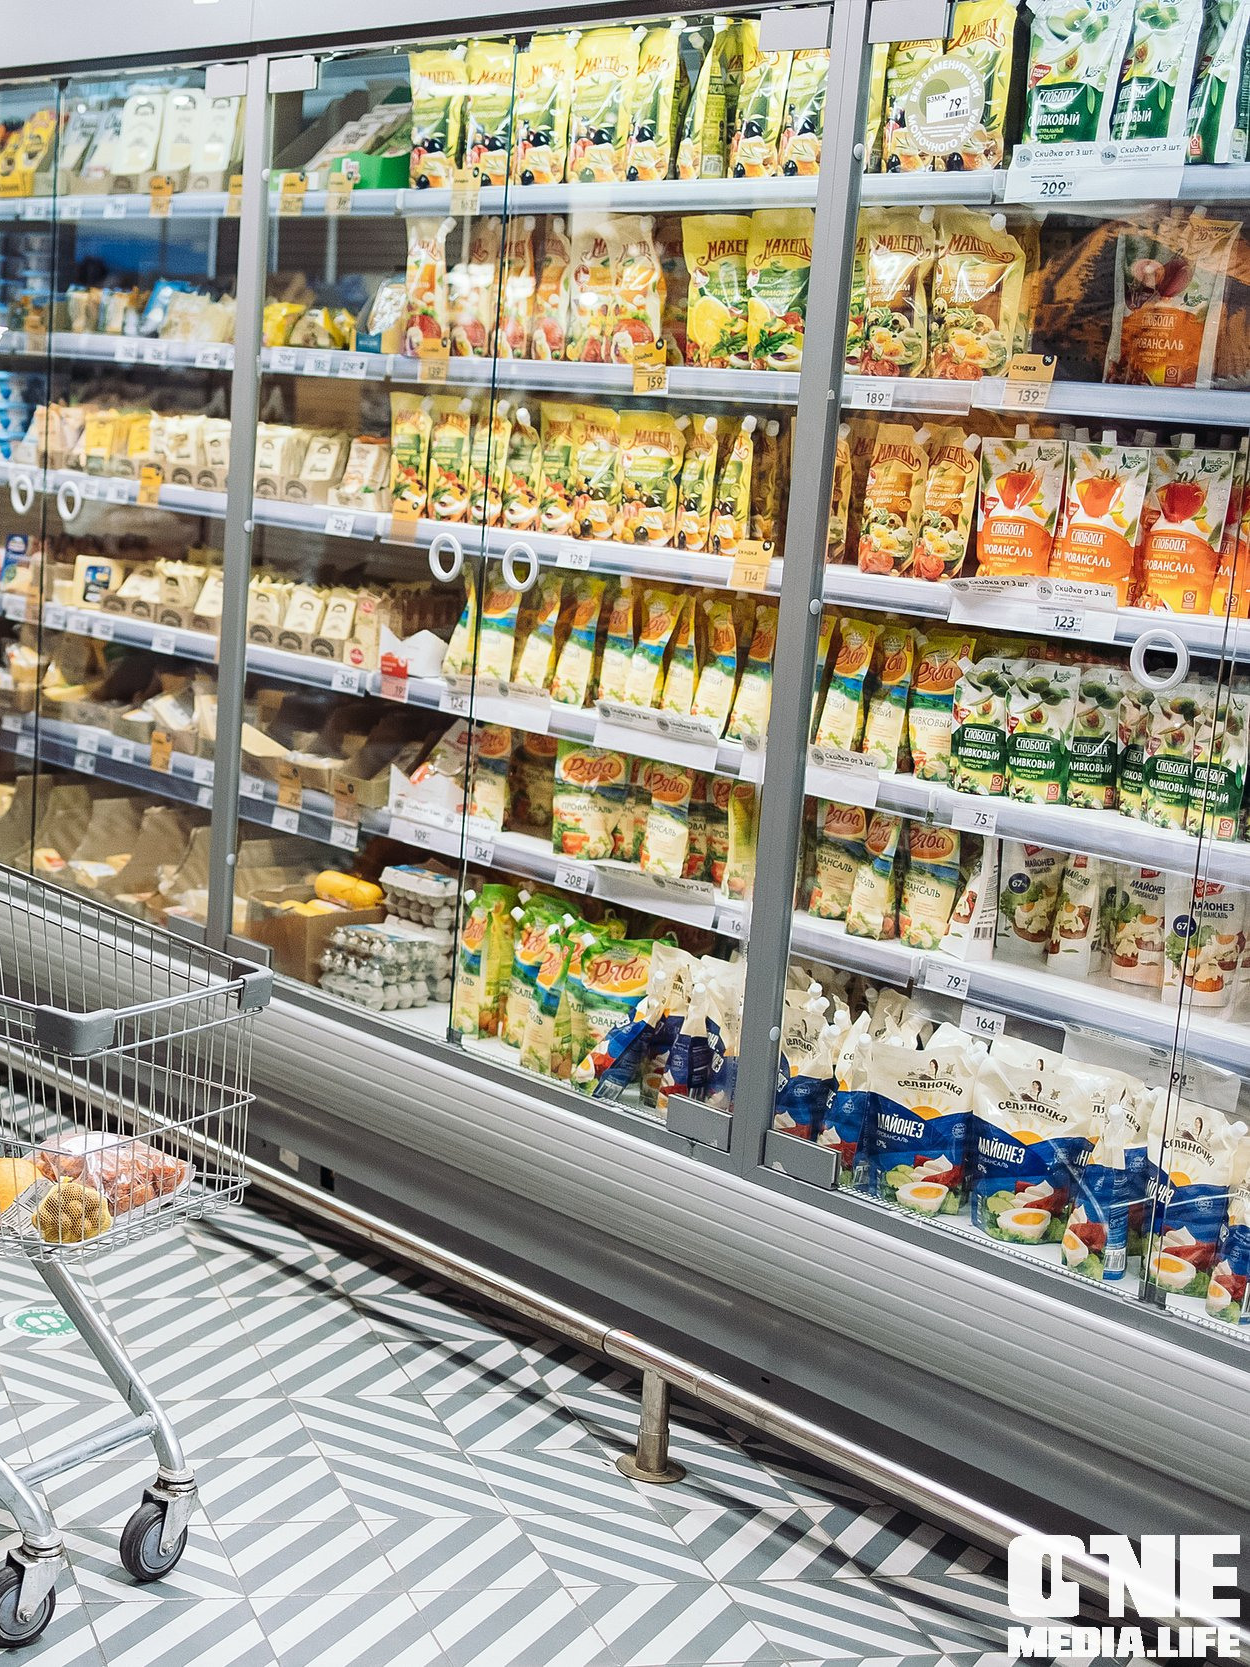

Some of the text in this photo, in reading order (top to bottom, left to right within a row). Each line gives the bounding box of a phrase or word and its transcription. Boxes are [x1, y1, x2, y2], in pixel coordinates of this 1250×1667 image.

[911, 59, 983, 103] БЕЗ ЗАМЕНИТЕЛЕЙ
[907, 114, 958, 153] МОЛОЧНОГО
[1034, 149, 1064, 158] Скидка
[1120, 145, 1149, 154] Скидка
[1040, 181, 1067, 195] 209
[866, 392, 885, 404] 189
[1017, 390, 1040, 402] 139
[991, 524, 1025, 536] СЛОБОДА
[1071, 531, 1104, 545] СЛОБОДА
[1152, 538, 1187, 552] СЛОБОДА
[1055, 584, 1082, 594] Скидка
[1054, 615, 1075, 628] 123
[964, 729, 997, 743] СЛОБОДА
[1015, 738, 1051, 752] СЛОБОДА
[1069, 761, 1112, 773] ЛИВКОВЫЙ
[1156, 761, 1189, 775] СЛОБОДА
[975, 813, 988, 825] 75
[1025, 858, 1055, 868] МАЙОНЕЗ
[564, 872, 582, 886] 208
[1130, 880, 1166, 895] МАЙОНЕЗ
[594, 957, 645, 985] Ряба
[947, 975, 961, 987] 79
[975, 1015, 995, 1031] 164
[898, 1079, 963, 1096] селяночка
[998, 1100, 1068, 1123] селяночка
[877, 1113, 925, 1139] МАЙОНЕЗ
[979, 1137, 1025, 1165] МАЙОНЕЗ
